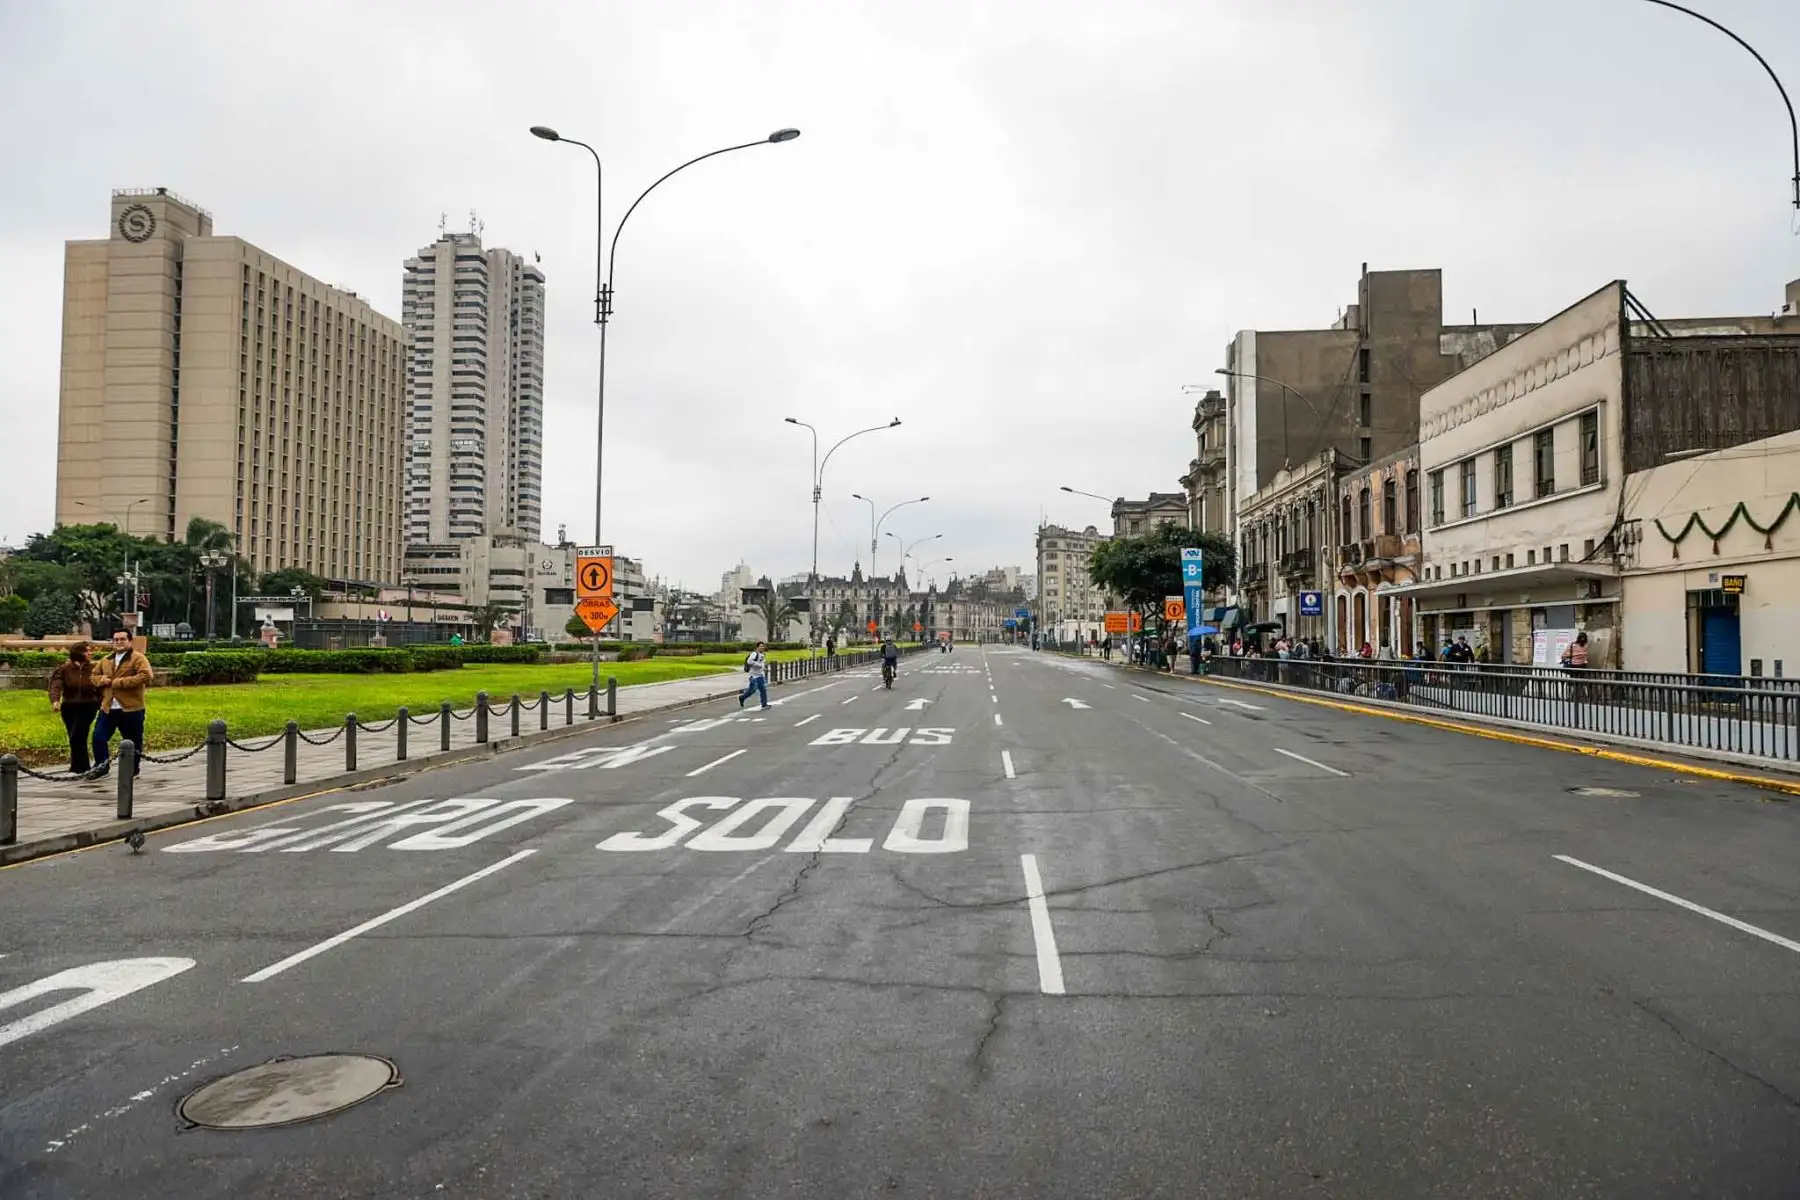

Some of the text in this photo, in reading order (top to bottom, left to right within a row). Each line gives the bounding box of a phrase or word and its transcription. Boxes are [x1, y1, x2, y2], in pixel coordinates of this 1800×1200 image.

[1187, 563, 1197, 576] B
[582, 600, 610, 608] OBRAS
[808, 728, 956, 745] BUS
[161, 798, 575, 853] GIRO
[595, 796, 971, 853] SOLO
